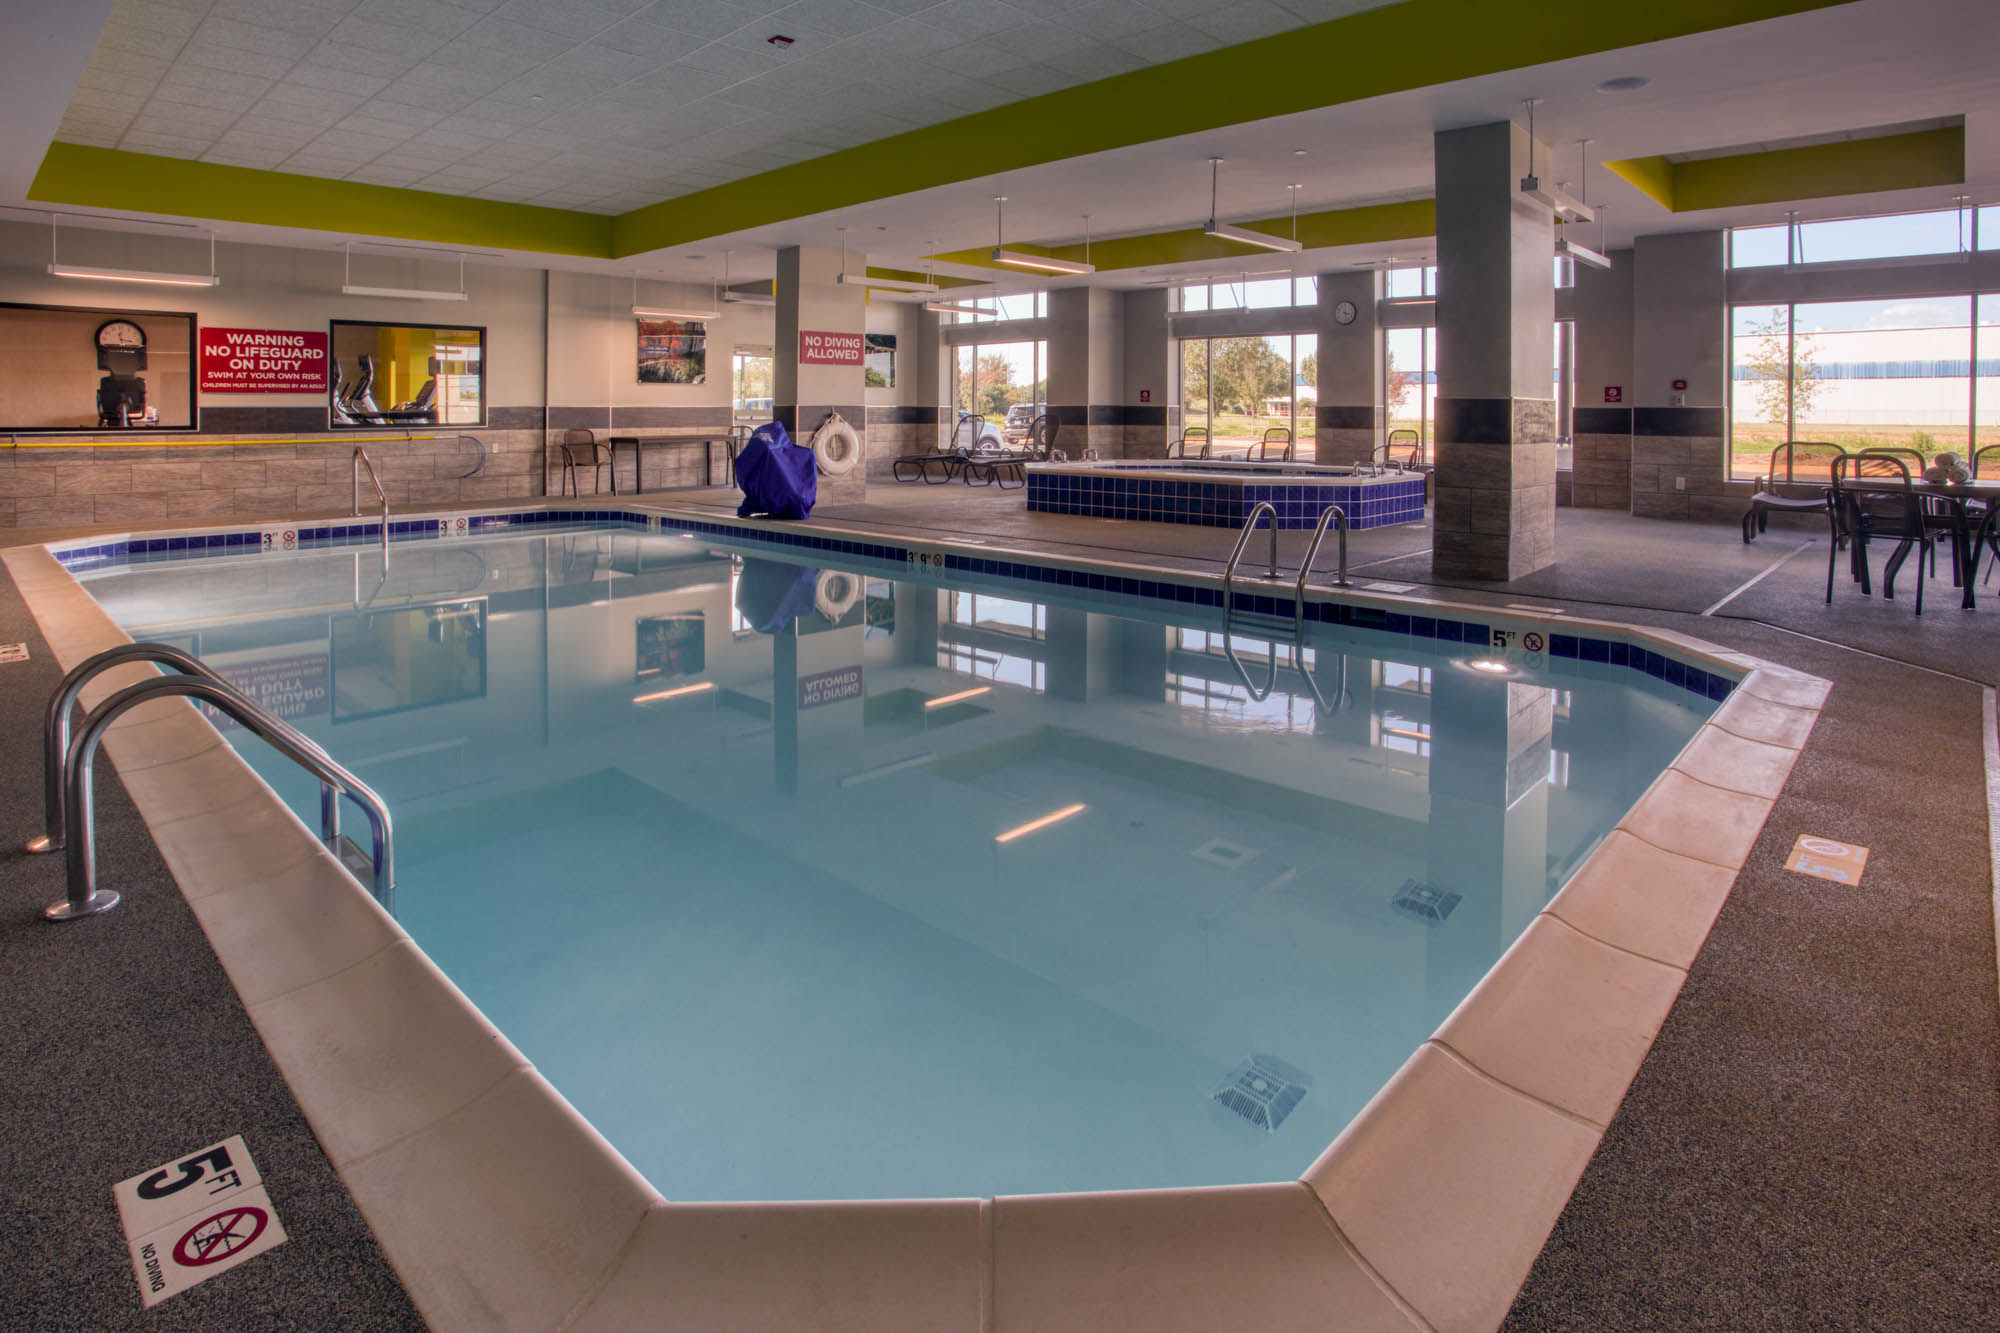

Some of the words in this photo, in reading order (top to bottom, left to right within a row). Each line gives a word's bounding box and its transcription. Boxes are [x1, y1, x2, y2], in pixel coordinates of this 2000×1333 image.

[226, 333, 304, 346] WARNING
[805, 335, 822, 346] NO
[825, 337, 861, 348] DIVING
[205, 345, 231, 357] NO
[236, 346, 324, 359] LIFEGUARD
[807, 348, 859, 360] ALLOWED
[229, 359, 254, 370] ON
[260, 360, 302, 371] DUTY
[207, 371, 234, 379] SWIM
[250, 372, 275, 380] YOUR
[441, 520, 448, 530] 3
[264, 533, 272, 544] 3
[1493, 630, 1507, 647] 5
[1507, 631, 1517, 639] FT
[136, 1145, 233, 1200] 5
[204, 1169, 243, 1195] FT
[140, 1242, 157, 1260] NO
[144, 1257, 166, 1294] DIVING
